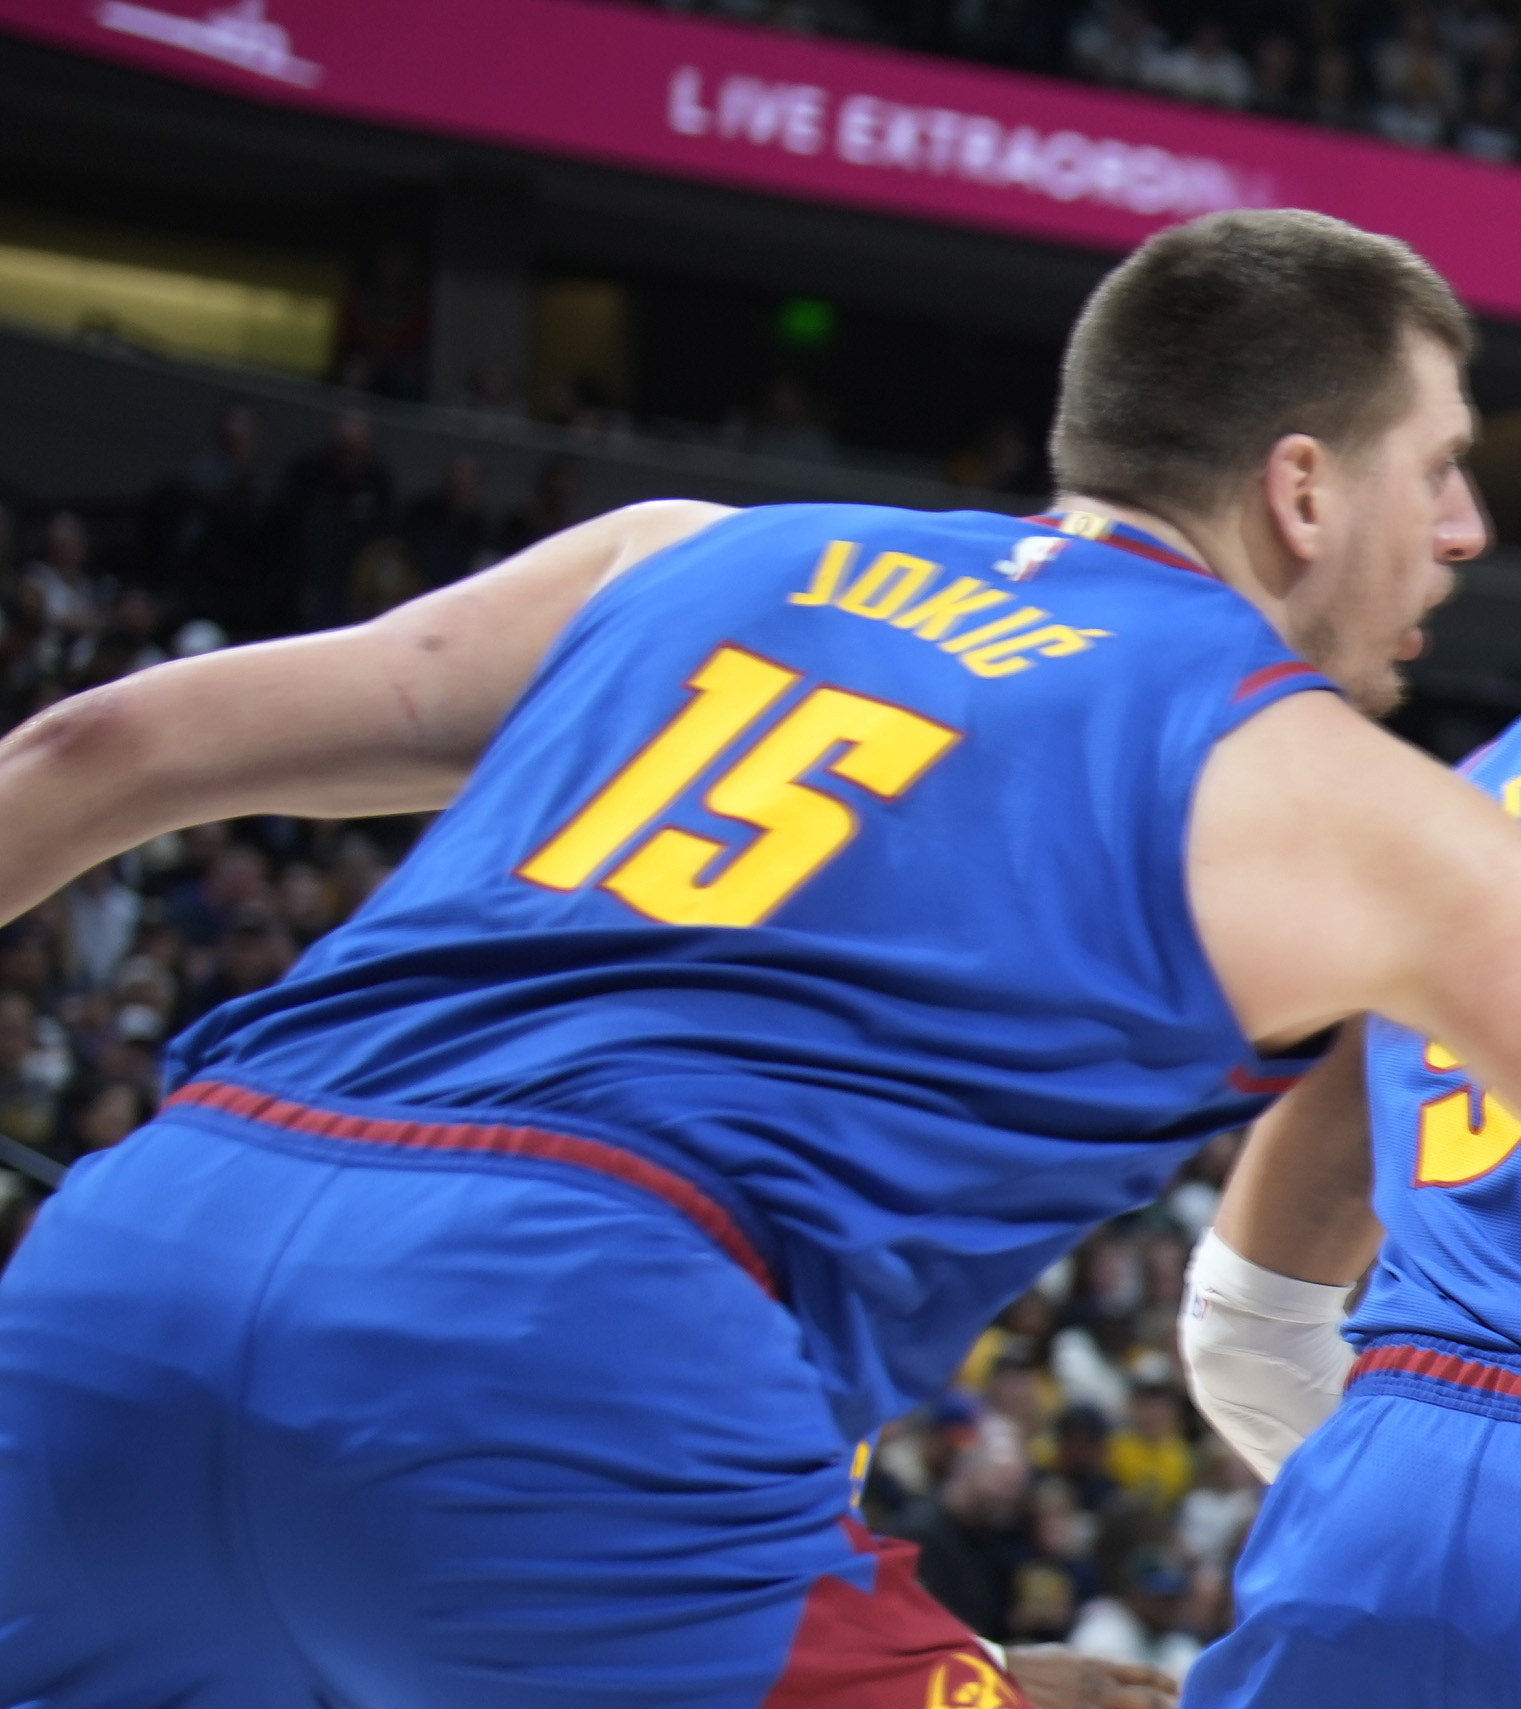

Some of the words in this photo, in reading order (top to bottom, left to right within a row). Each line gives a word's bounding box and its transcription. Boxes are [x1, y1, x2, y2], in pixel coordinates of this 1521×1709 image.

[667, 66, 830, 156] LIVE
[787, 540, 1116, 679] JOKIĆ
[512, 639, 967, 928] 15
